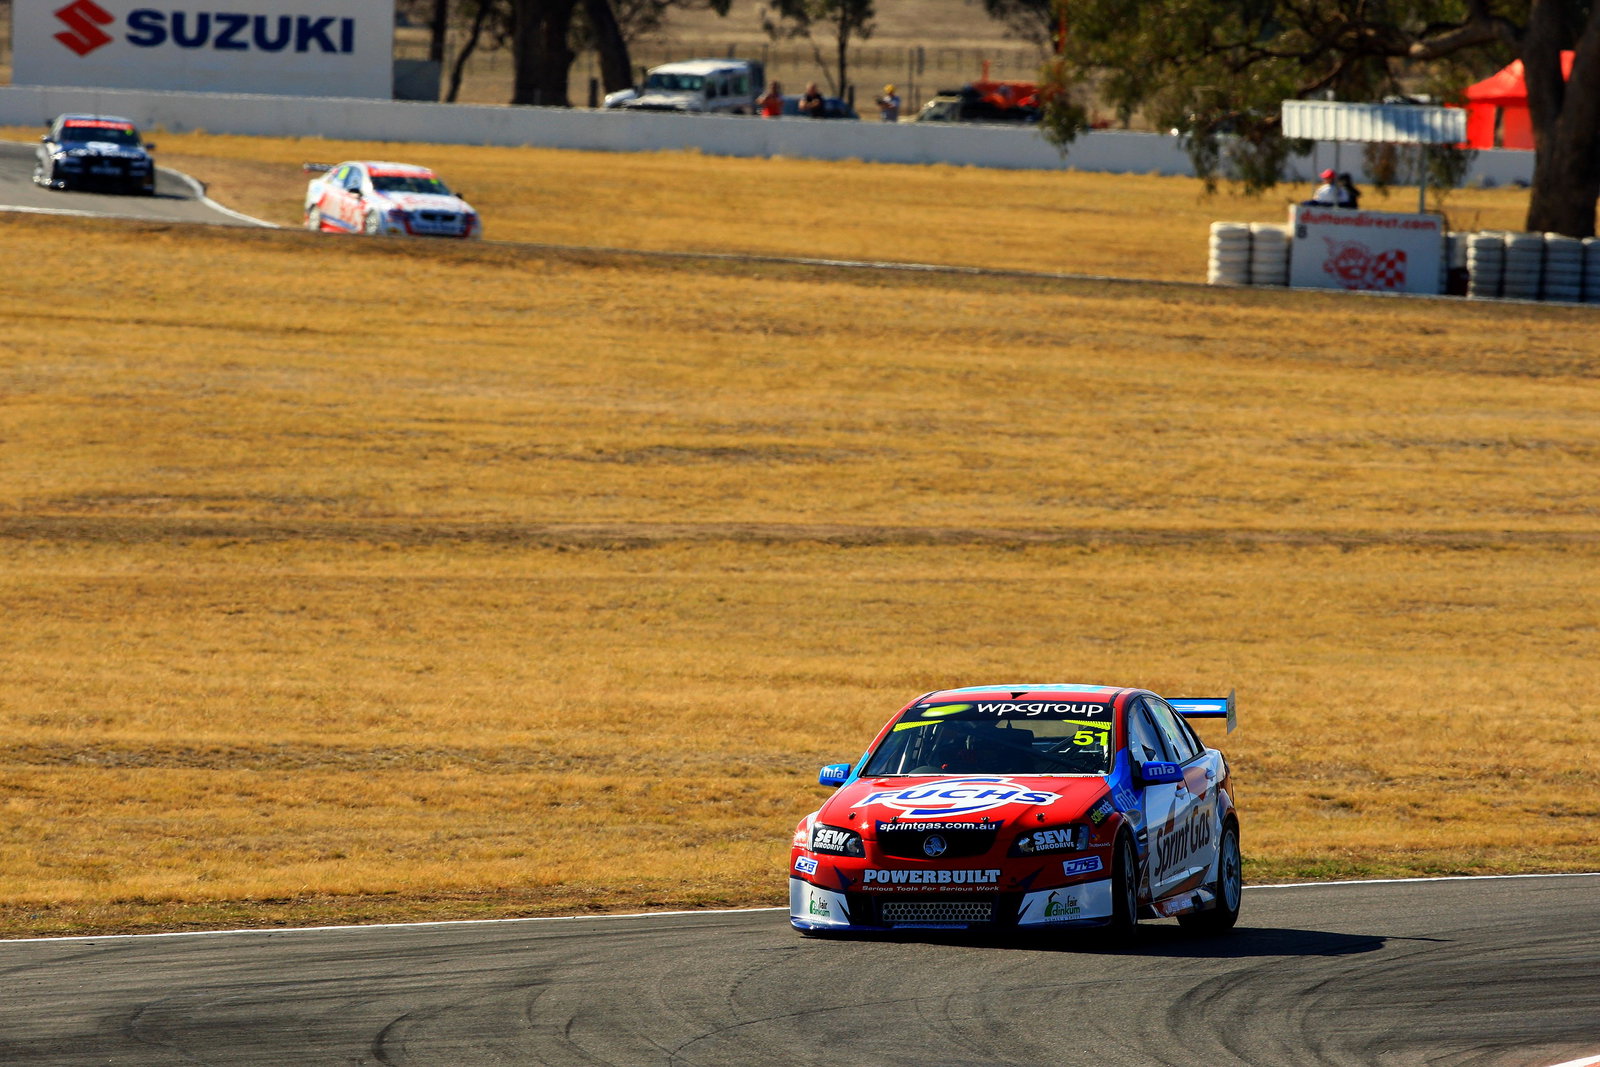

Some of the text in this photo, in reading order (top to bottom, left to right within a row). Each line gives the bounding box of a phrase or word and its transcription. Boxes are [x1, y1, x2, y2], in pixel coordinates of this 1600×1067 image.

[125, 8, 354, 54] SUZUKI
[977, 703, 1104, 717] wpcgroup
[1072, 730, 1109, 746] 51
[860, 788, 1055, 805] FUCHS
[879, 821, 997, 832] sprintgas.com.au
[815, 829, 850, 845] SEW
[1033, 829, 1072, 845] SEW
[812, 842, 845, 852] EURODRIVE
[1035, 841, 1075, 851] EURODRIVE
[1154, 805, 1210, 886] Sprint Gas
[863, 869, 1001, 884] POWERBUILT
[1053, 902, 1081, 916] dinkum
[1067, 895, 1078, 908] fair
